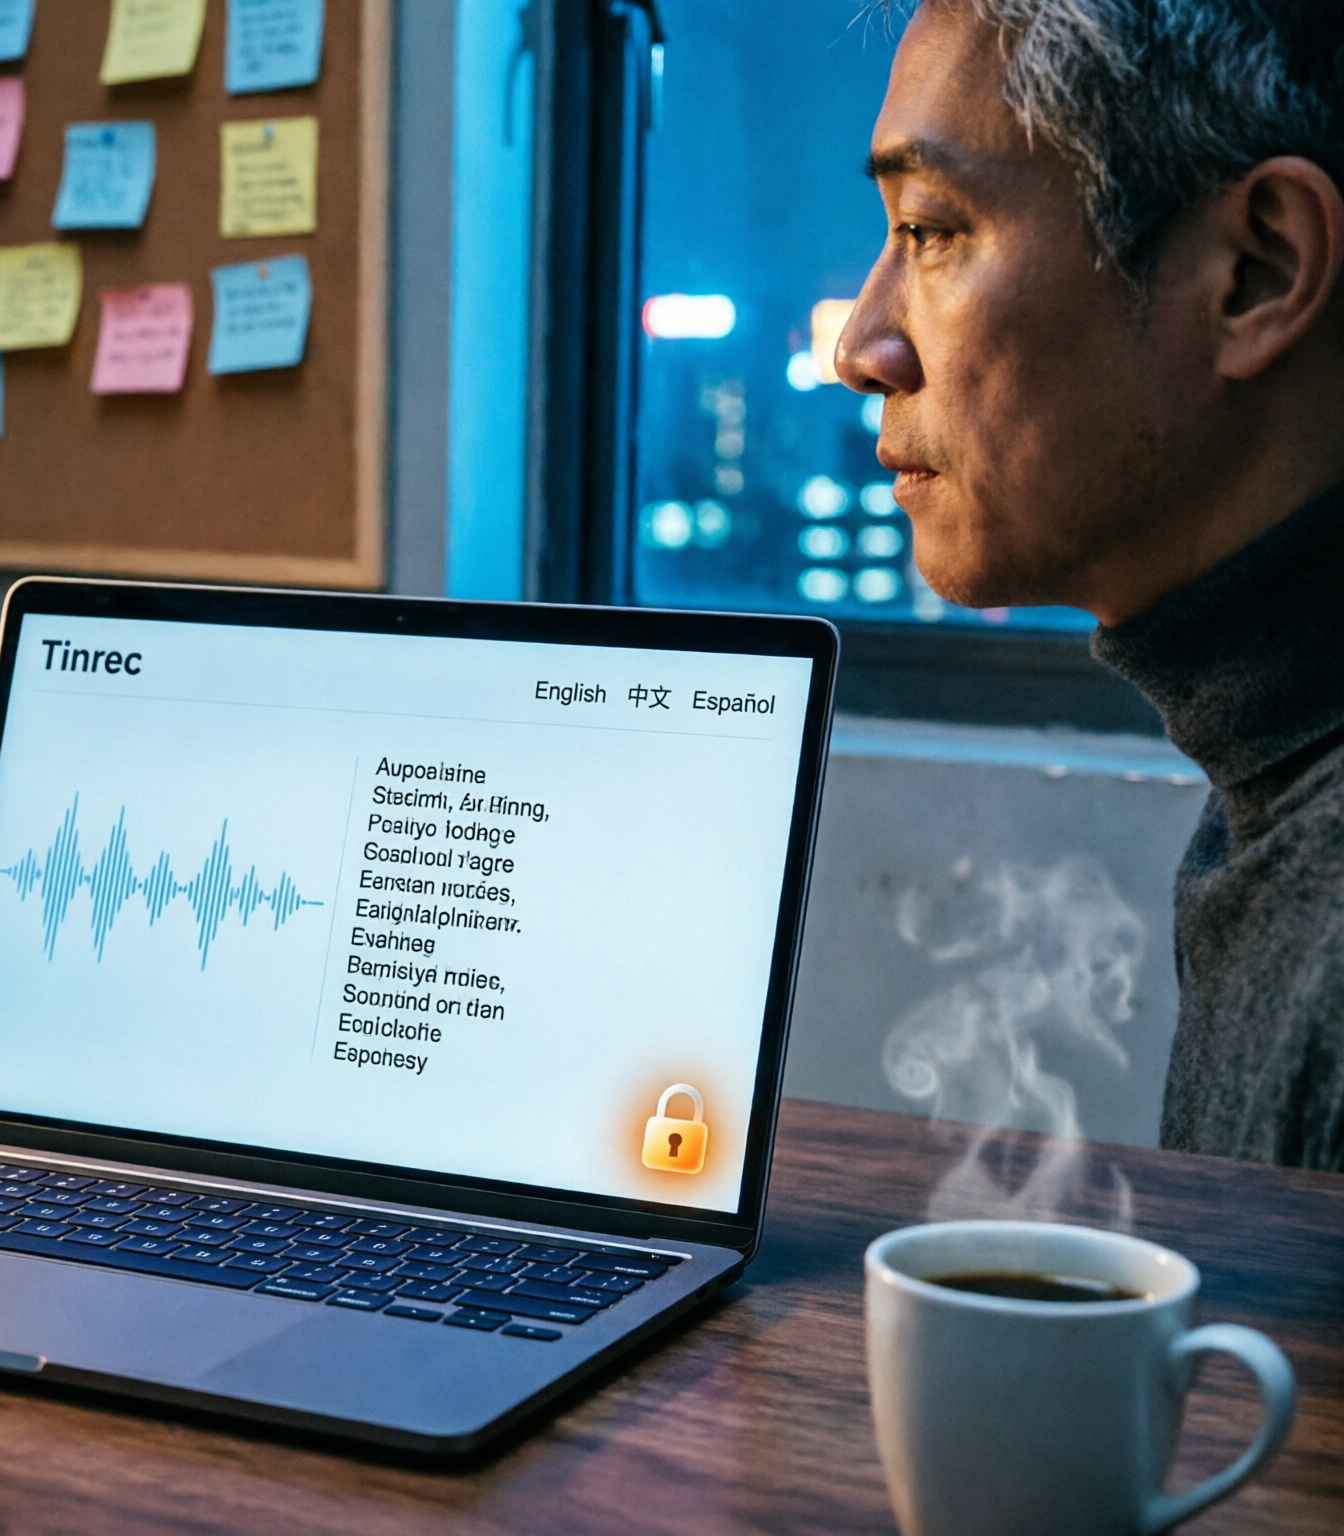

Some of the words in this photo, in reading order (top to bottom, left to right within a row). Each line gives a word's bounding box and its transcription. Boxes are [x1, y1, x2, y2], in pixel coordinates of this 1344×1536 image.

[42, 639, 142, 676] Tinrec
[535, 681, 606, 705] English
[627, 684, 671, 709] 中文
[693, 690, 775, 716] Español
